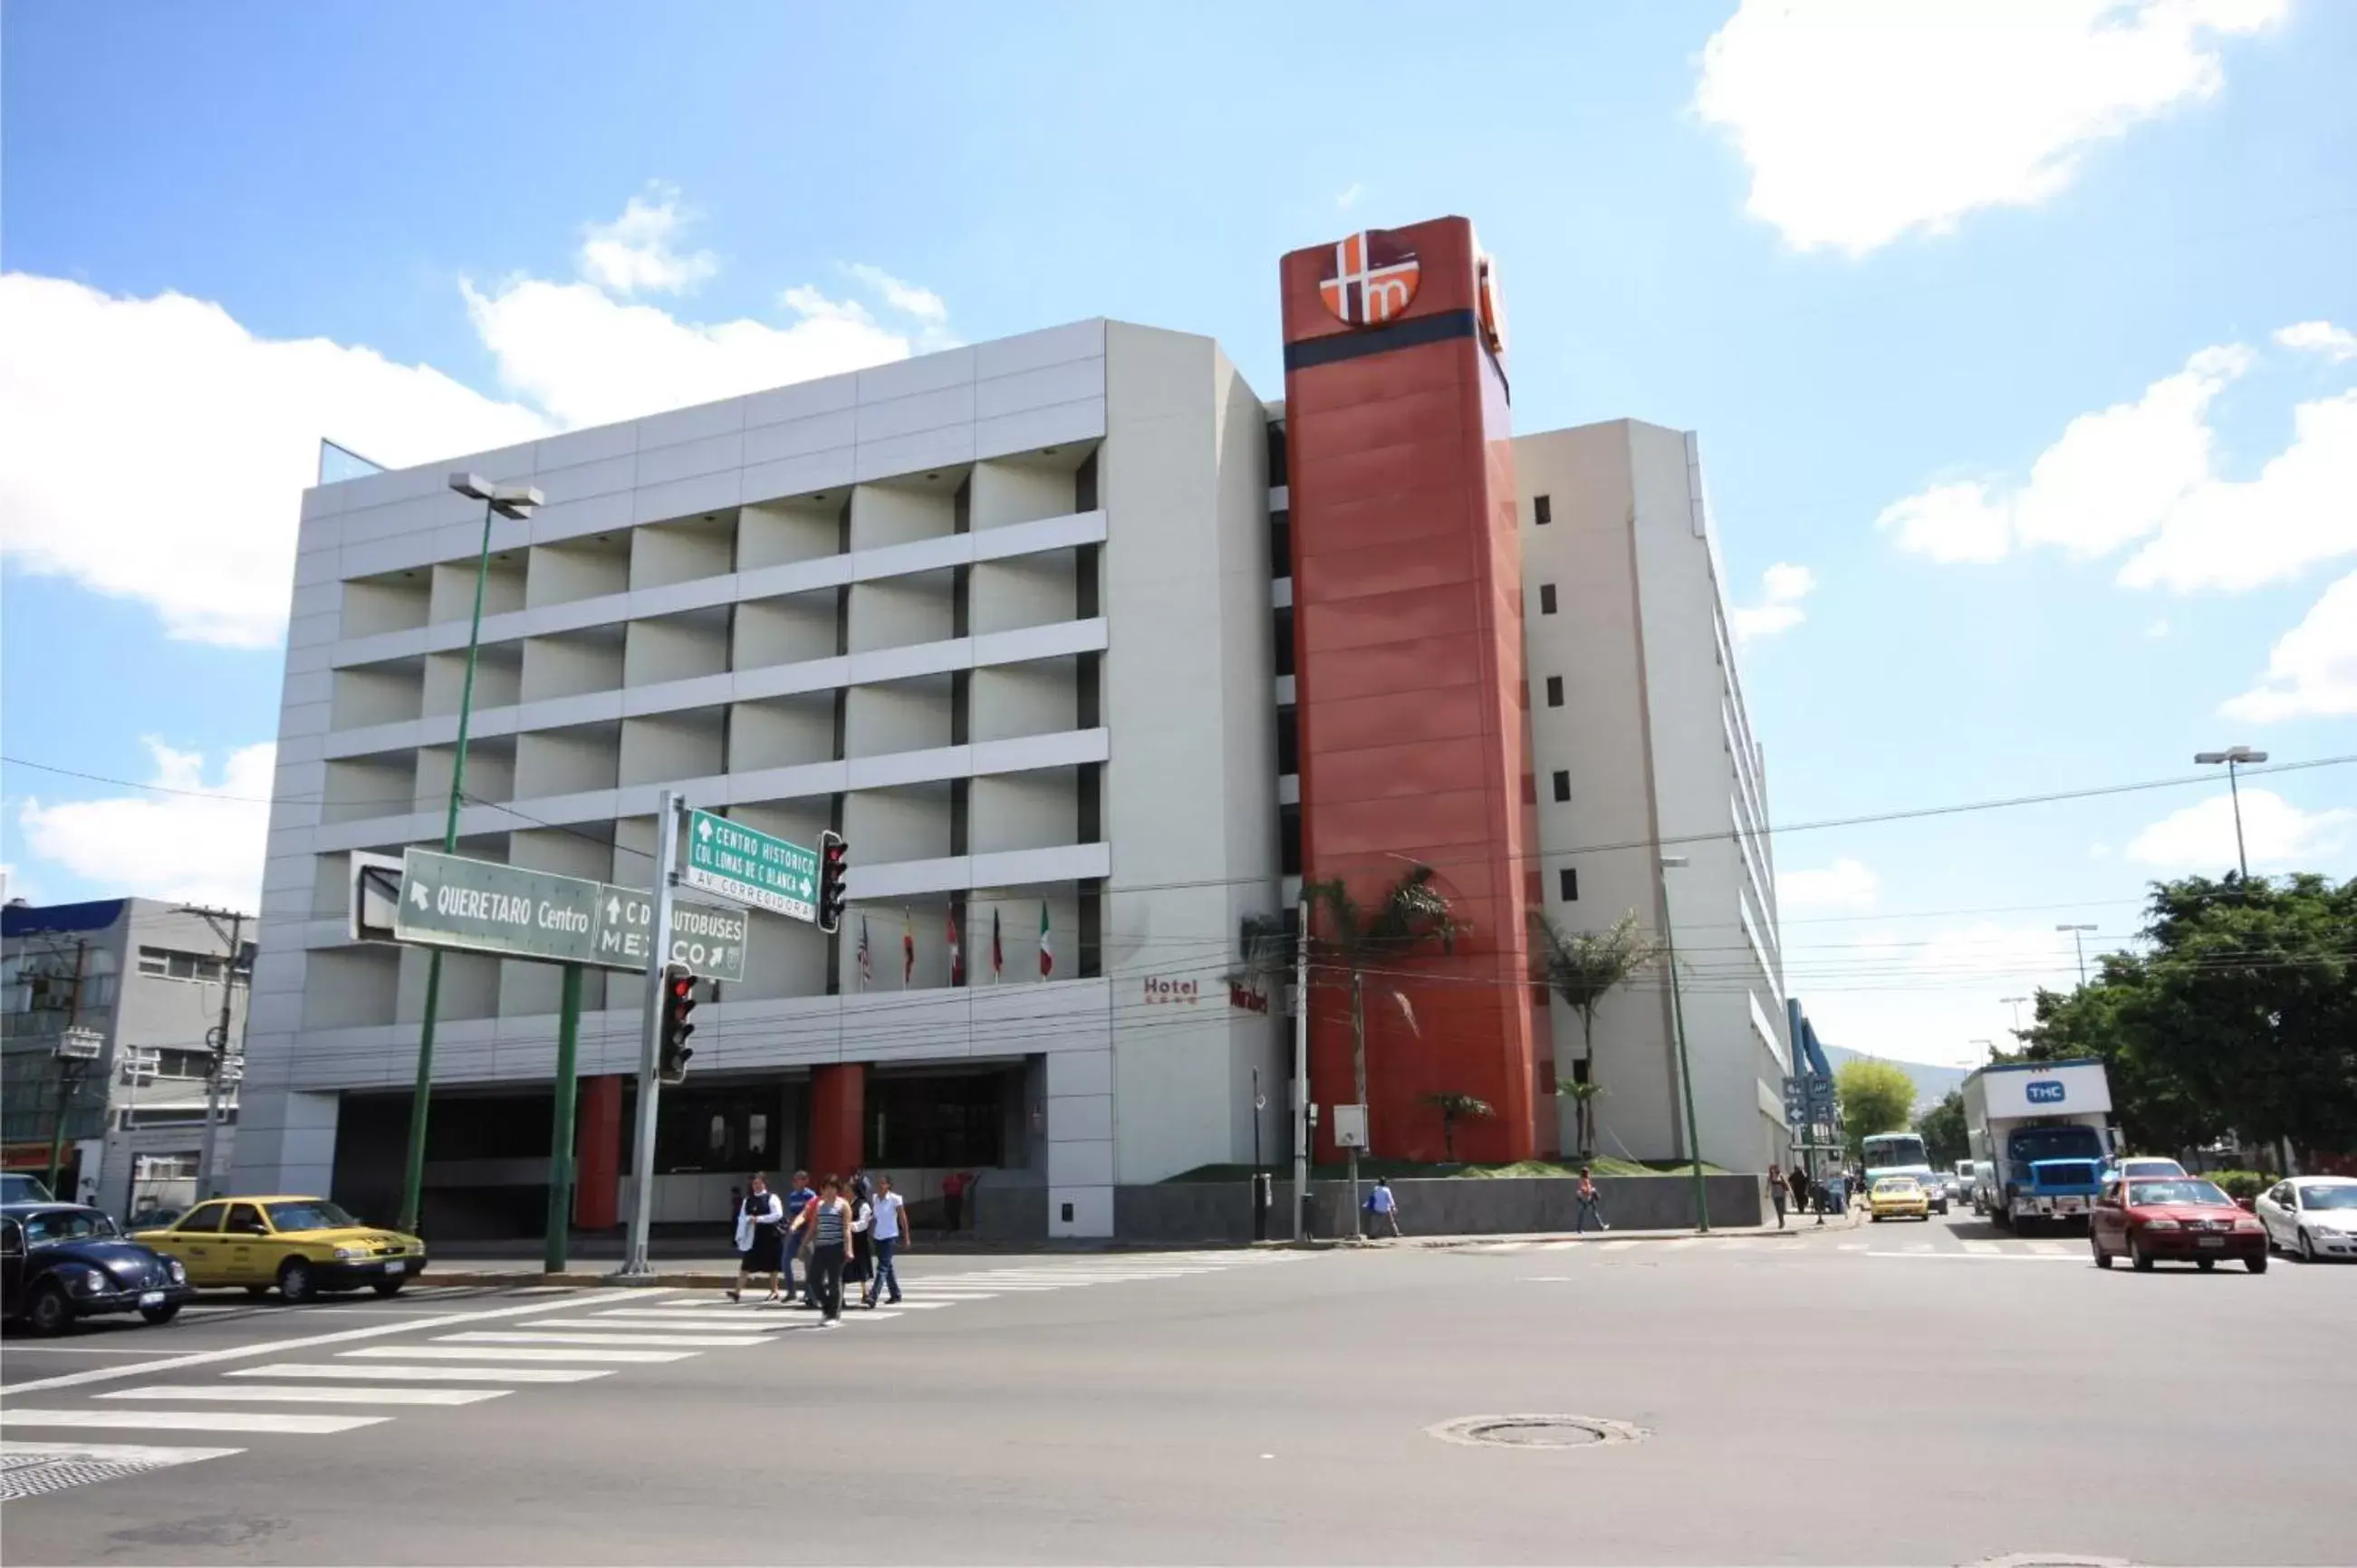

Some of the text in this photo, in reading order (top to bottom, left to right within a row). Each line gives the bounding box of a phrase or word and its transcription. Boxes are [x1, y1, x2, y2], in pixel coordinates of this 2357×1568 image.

[716, 826, 815, 876] CENTRO HISTORICO
[716, 851, 743, 875] LOMAS
[438, 885, 589, 933] QUERETARO Centro
[670, 910, 742, 940] UTOBUSES
[601, 929, 706, 965] MECO
[1144, 977, 1198, 995] Hotel
